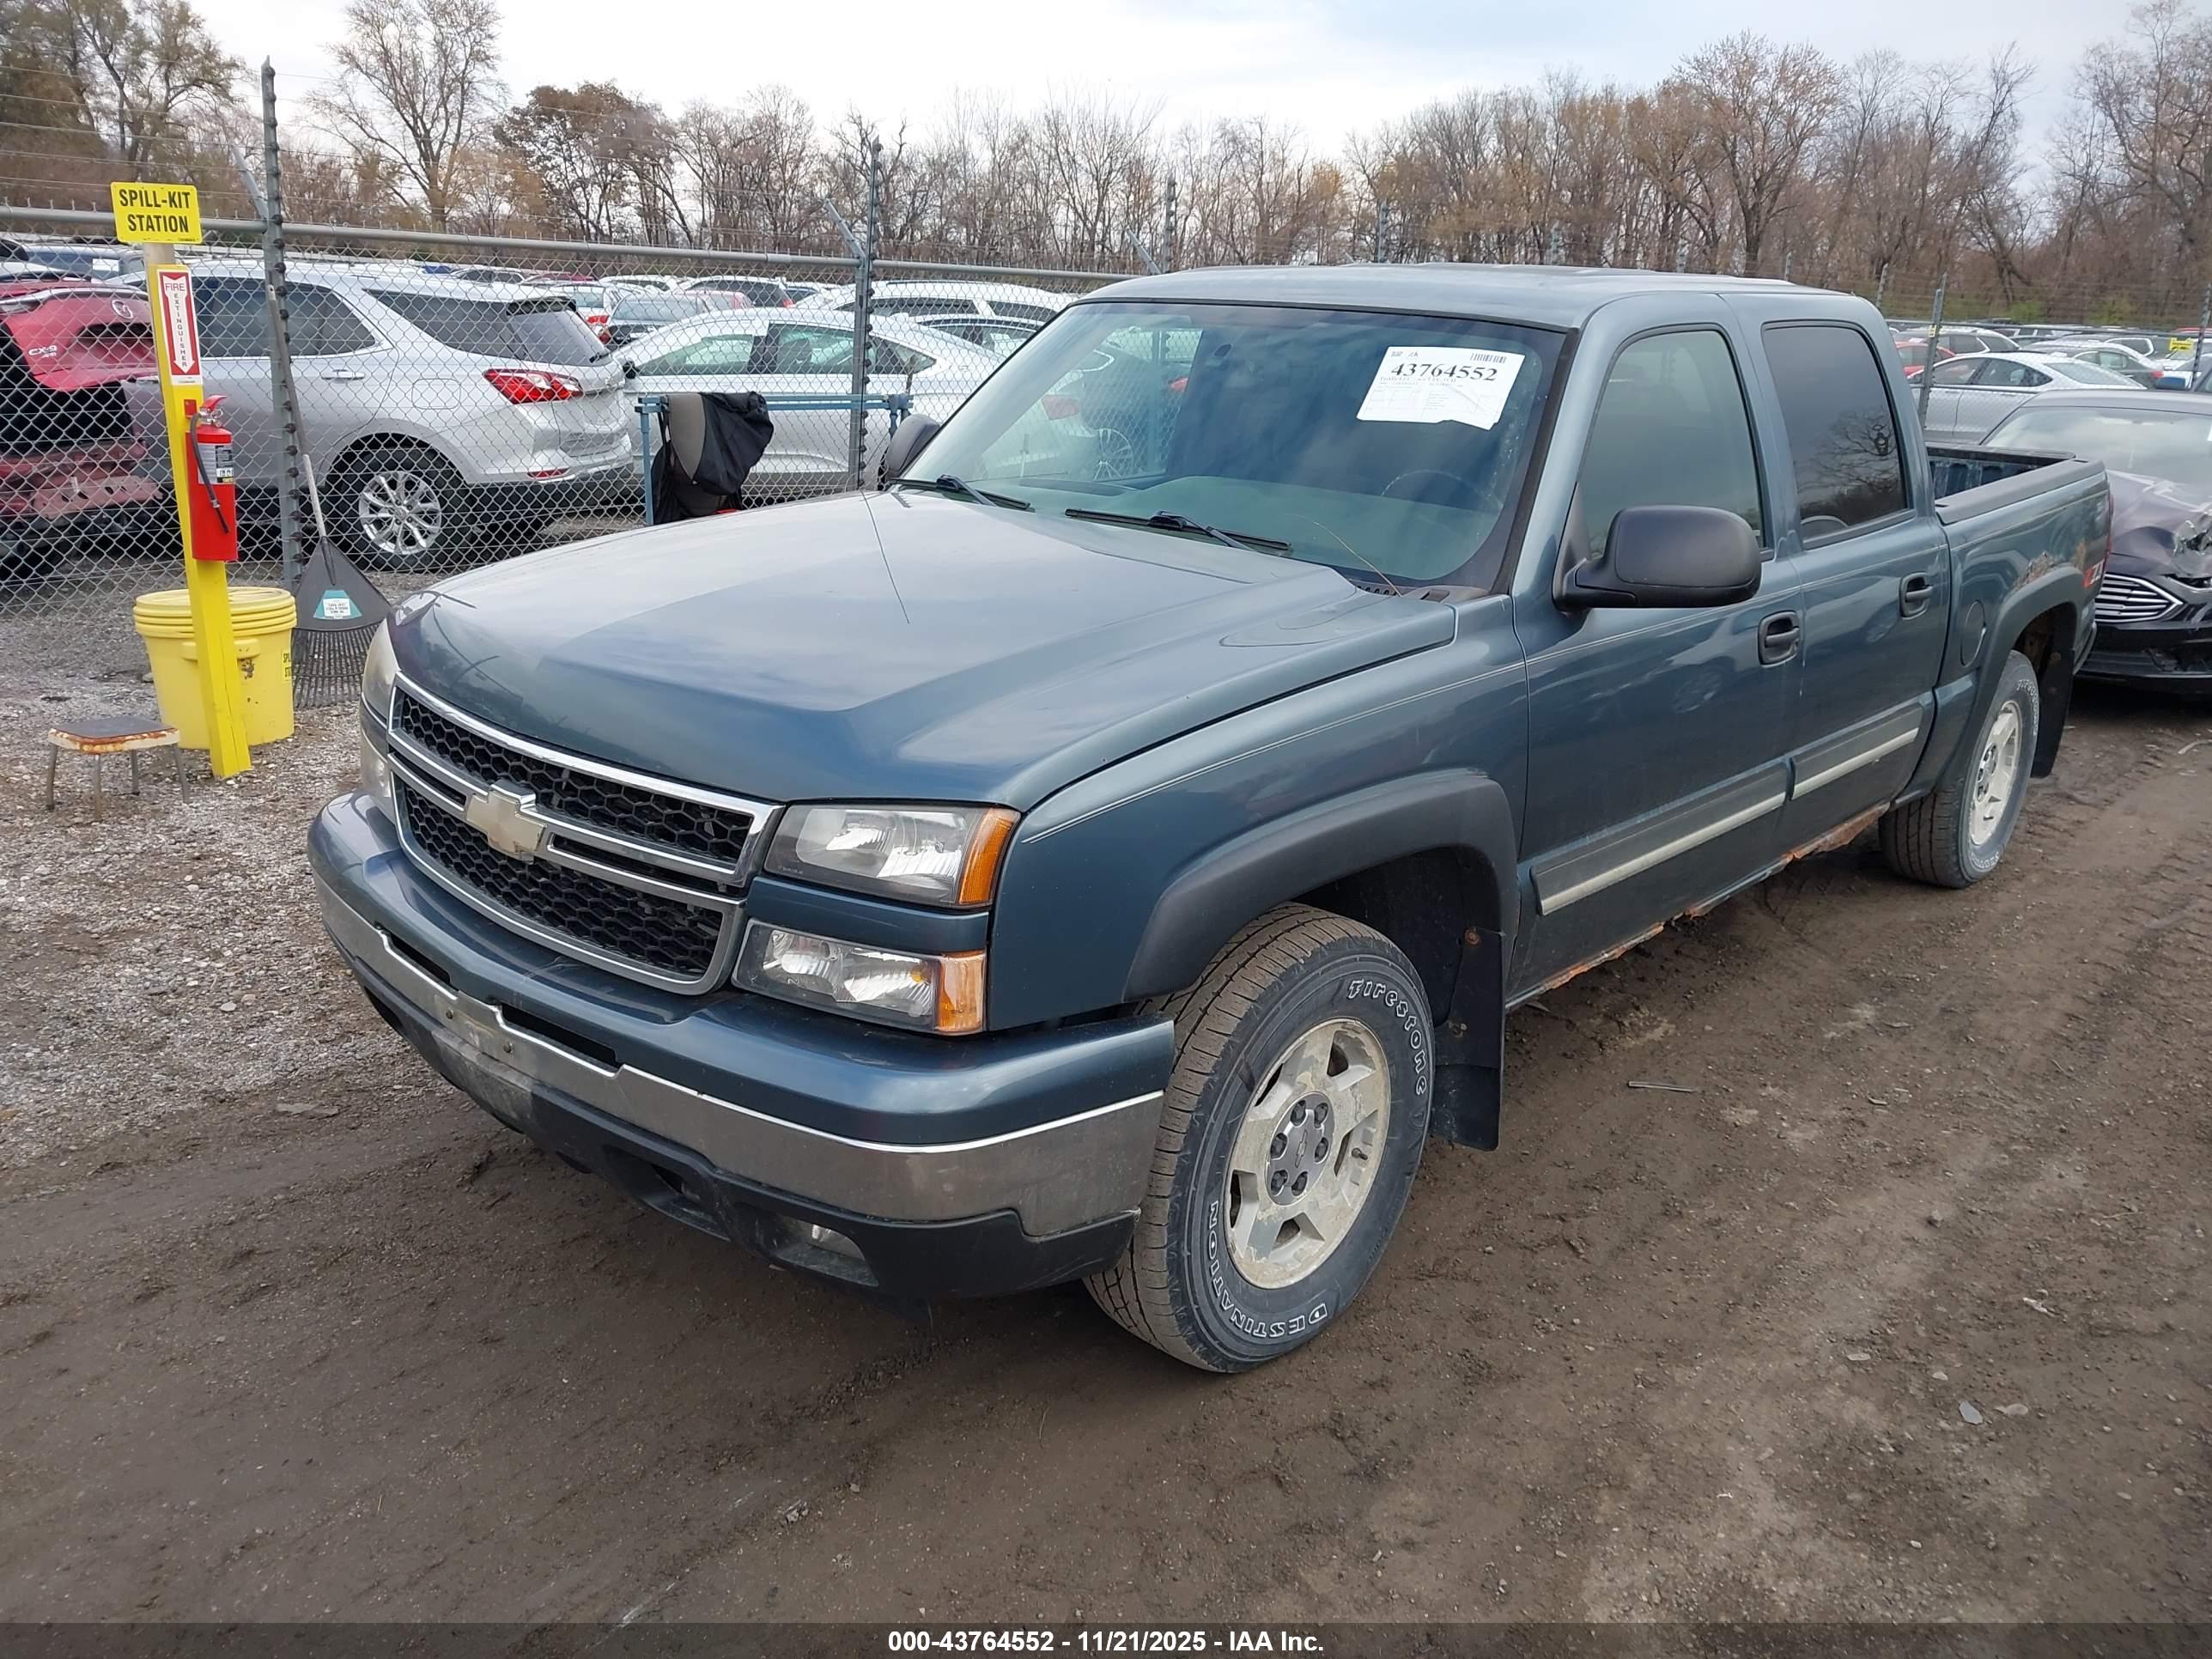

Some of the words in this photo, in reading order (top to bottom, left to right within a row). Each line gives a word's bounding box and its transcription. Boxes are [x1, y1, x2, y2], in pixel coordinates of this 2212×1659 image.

[118, 188, 191, 209] SPILL-KIT
[127, 213, 189, 233] STATION
[164, 282, 186, 292] FIRE
[173, 292, 187, 368] EXTINGUISHER
[1391, 362, 1498, 382] 43764552
[1347, 978, 1427, 1096] Firestone
[1207, 1200, 1328, 1338] DESTINATION
